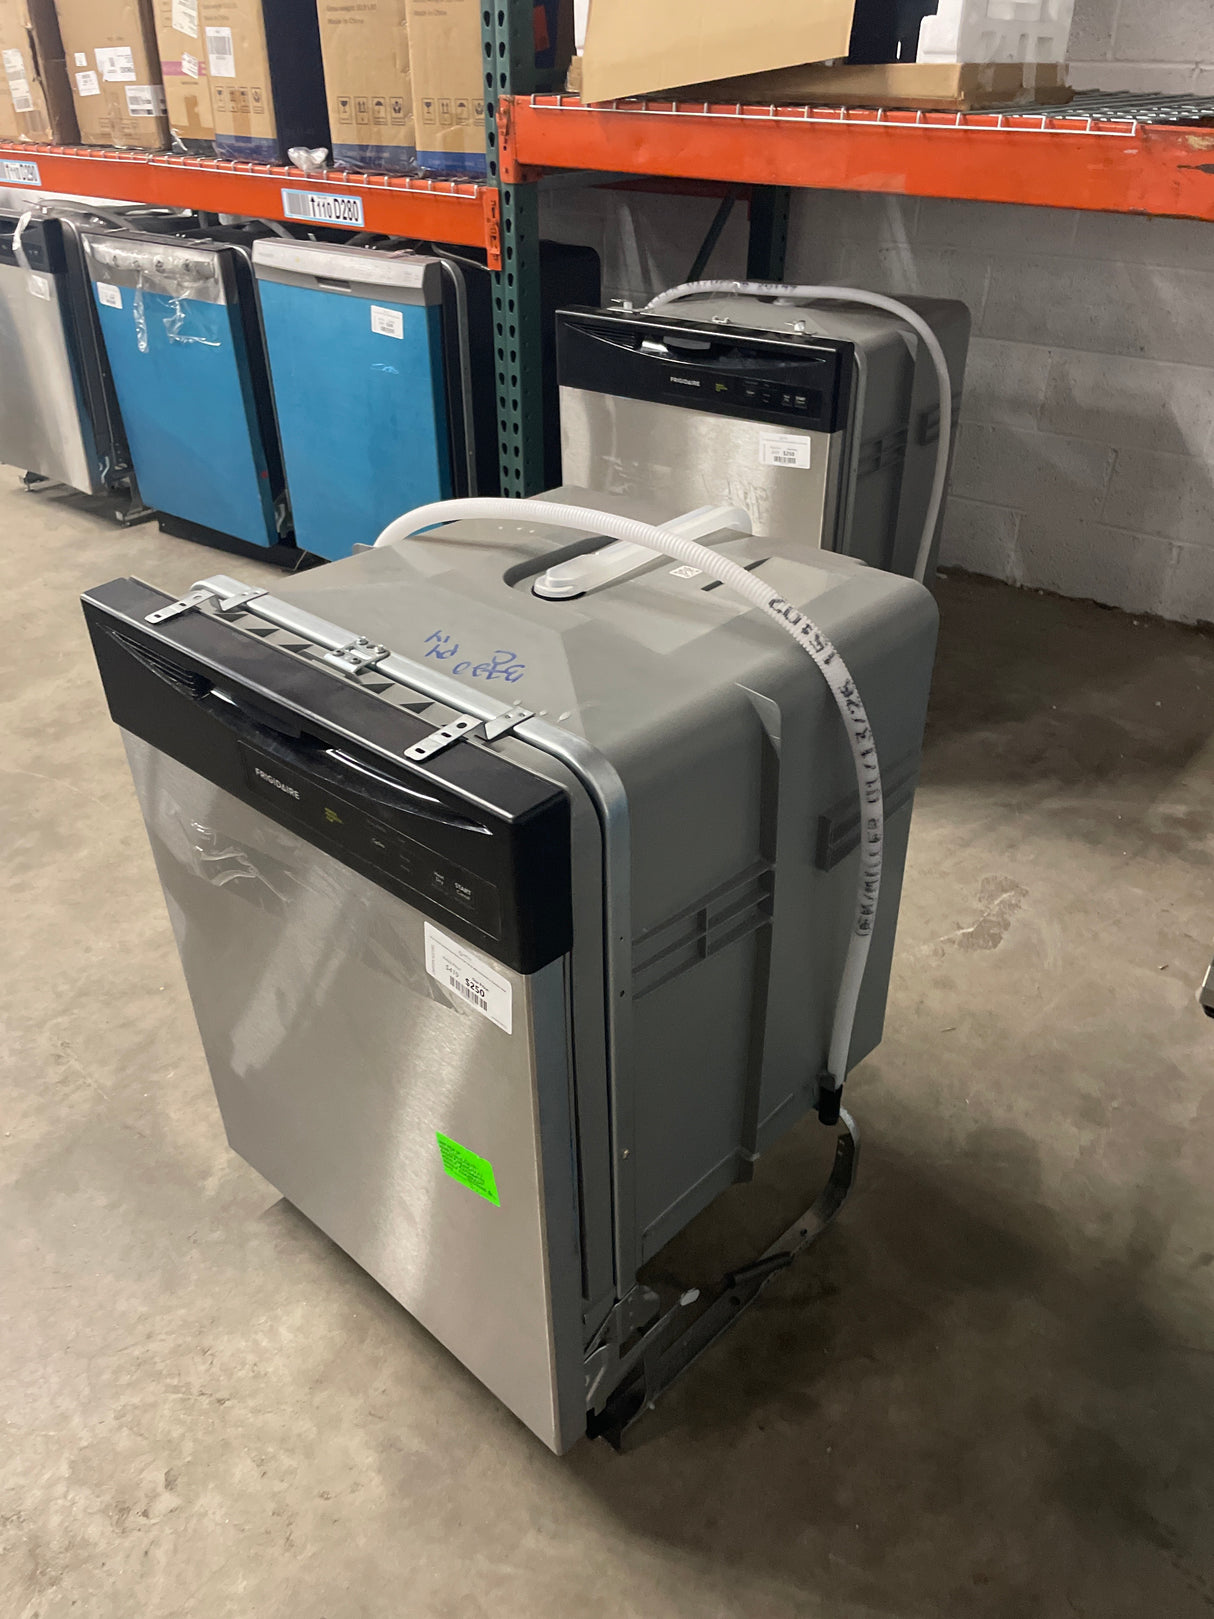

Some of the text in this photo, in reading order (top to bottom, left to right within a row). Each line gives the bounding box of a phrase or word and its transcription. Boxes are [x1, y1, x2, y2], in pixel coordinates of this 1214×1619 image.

[333, 198, 360, 222] D280
[254, 767, 301, 801] FRIGIDAIRE
[464, 978, 486, 998] $250
